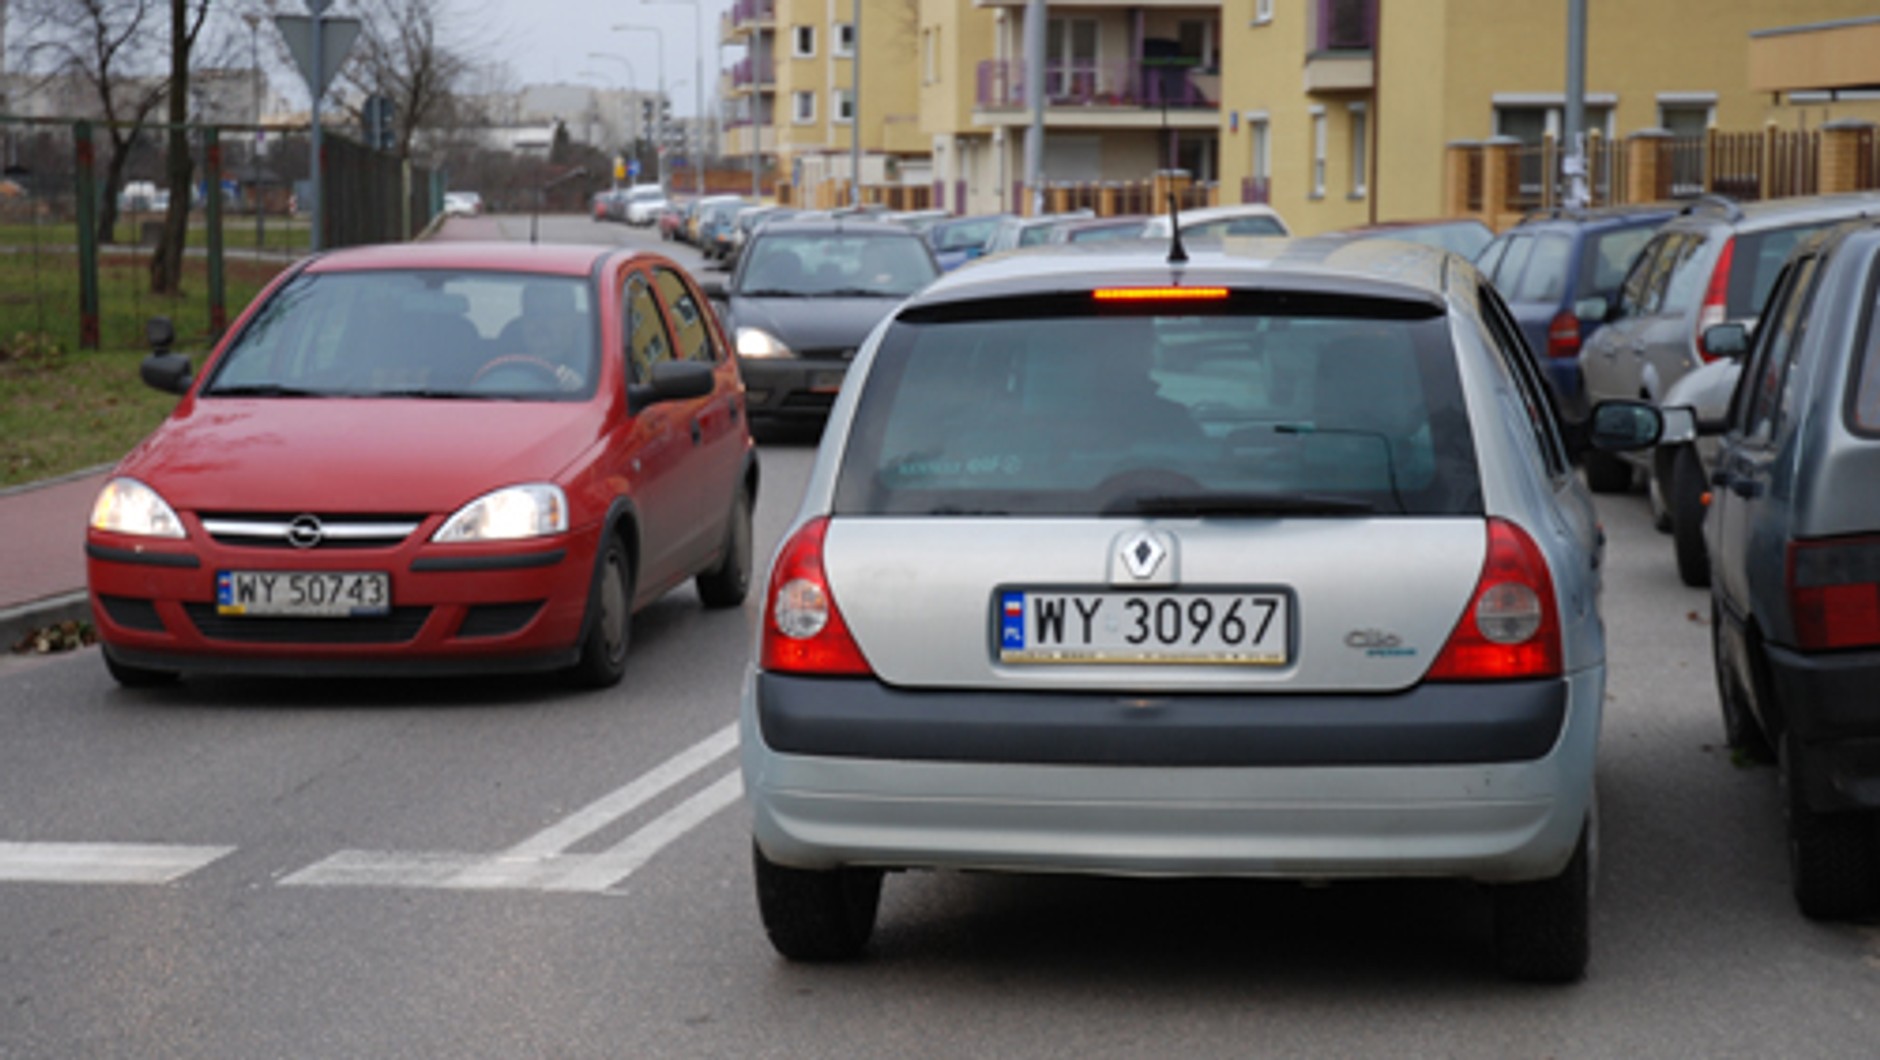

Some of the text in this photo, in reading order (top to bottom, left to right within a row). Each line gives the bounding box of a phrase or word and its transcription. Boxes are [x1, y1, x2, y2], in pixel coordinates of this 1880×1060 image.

[237, 574, 384, 605] WY 50743
[1034, 598, 1280, 646] WY 30967
